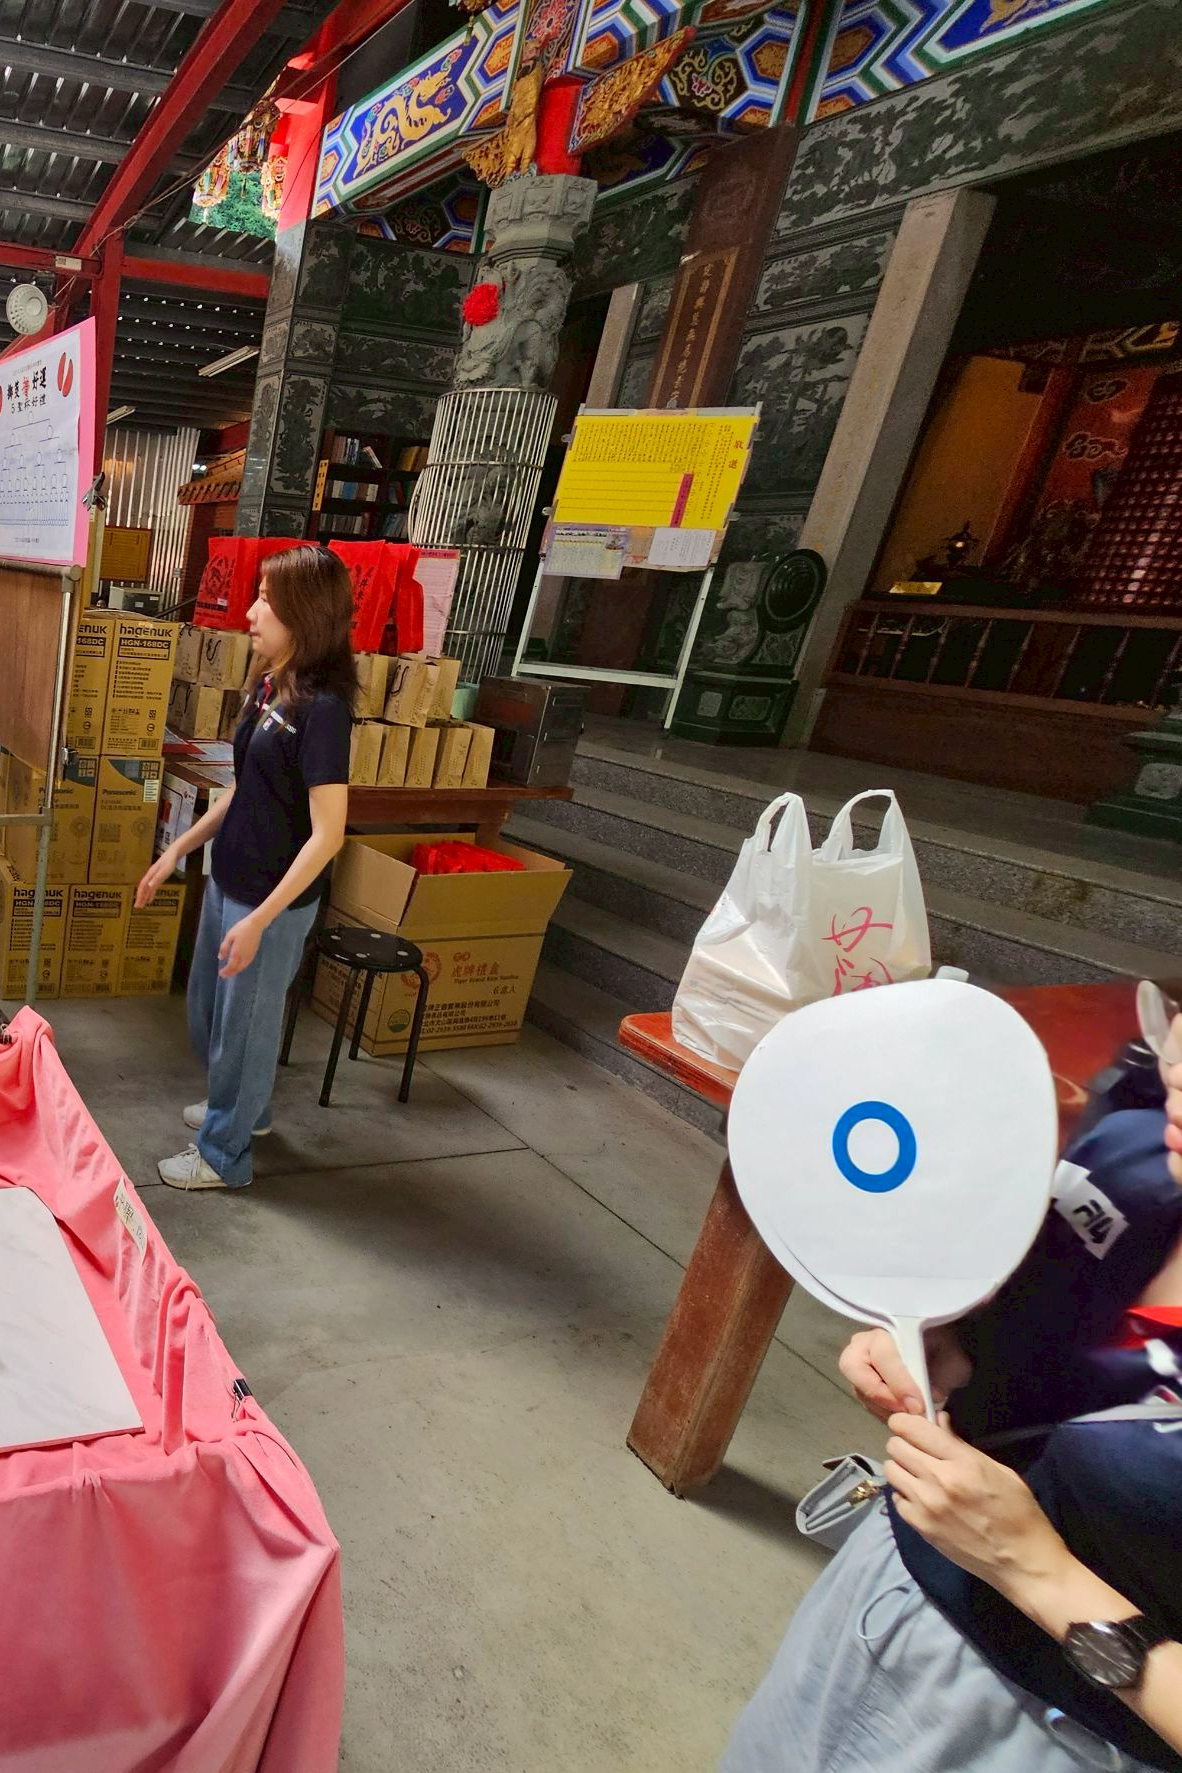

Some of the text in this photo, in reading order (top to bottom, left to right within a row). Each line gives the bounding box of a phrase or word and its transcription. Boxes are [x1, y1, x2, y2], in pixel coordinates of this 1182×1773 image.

[120, 623, 173, 637] hagenuk
[121, 640, 170, 649] HGN-168DC
[73, 888, 122, 899] hagenuk
